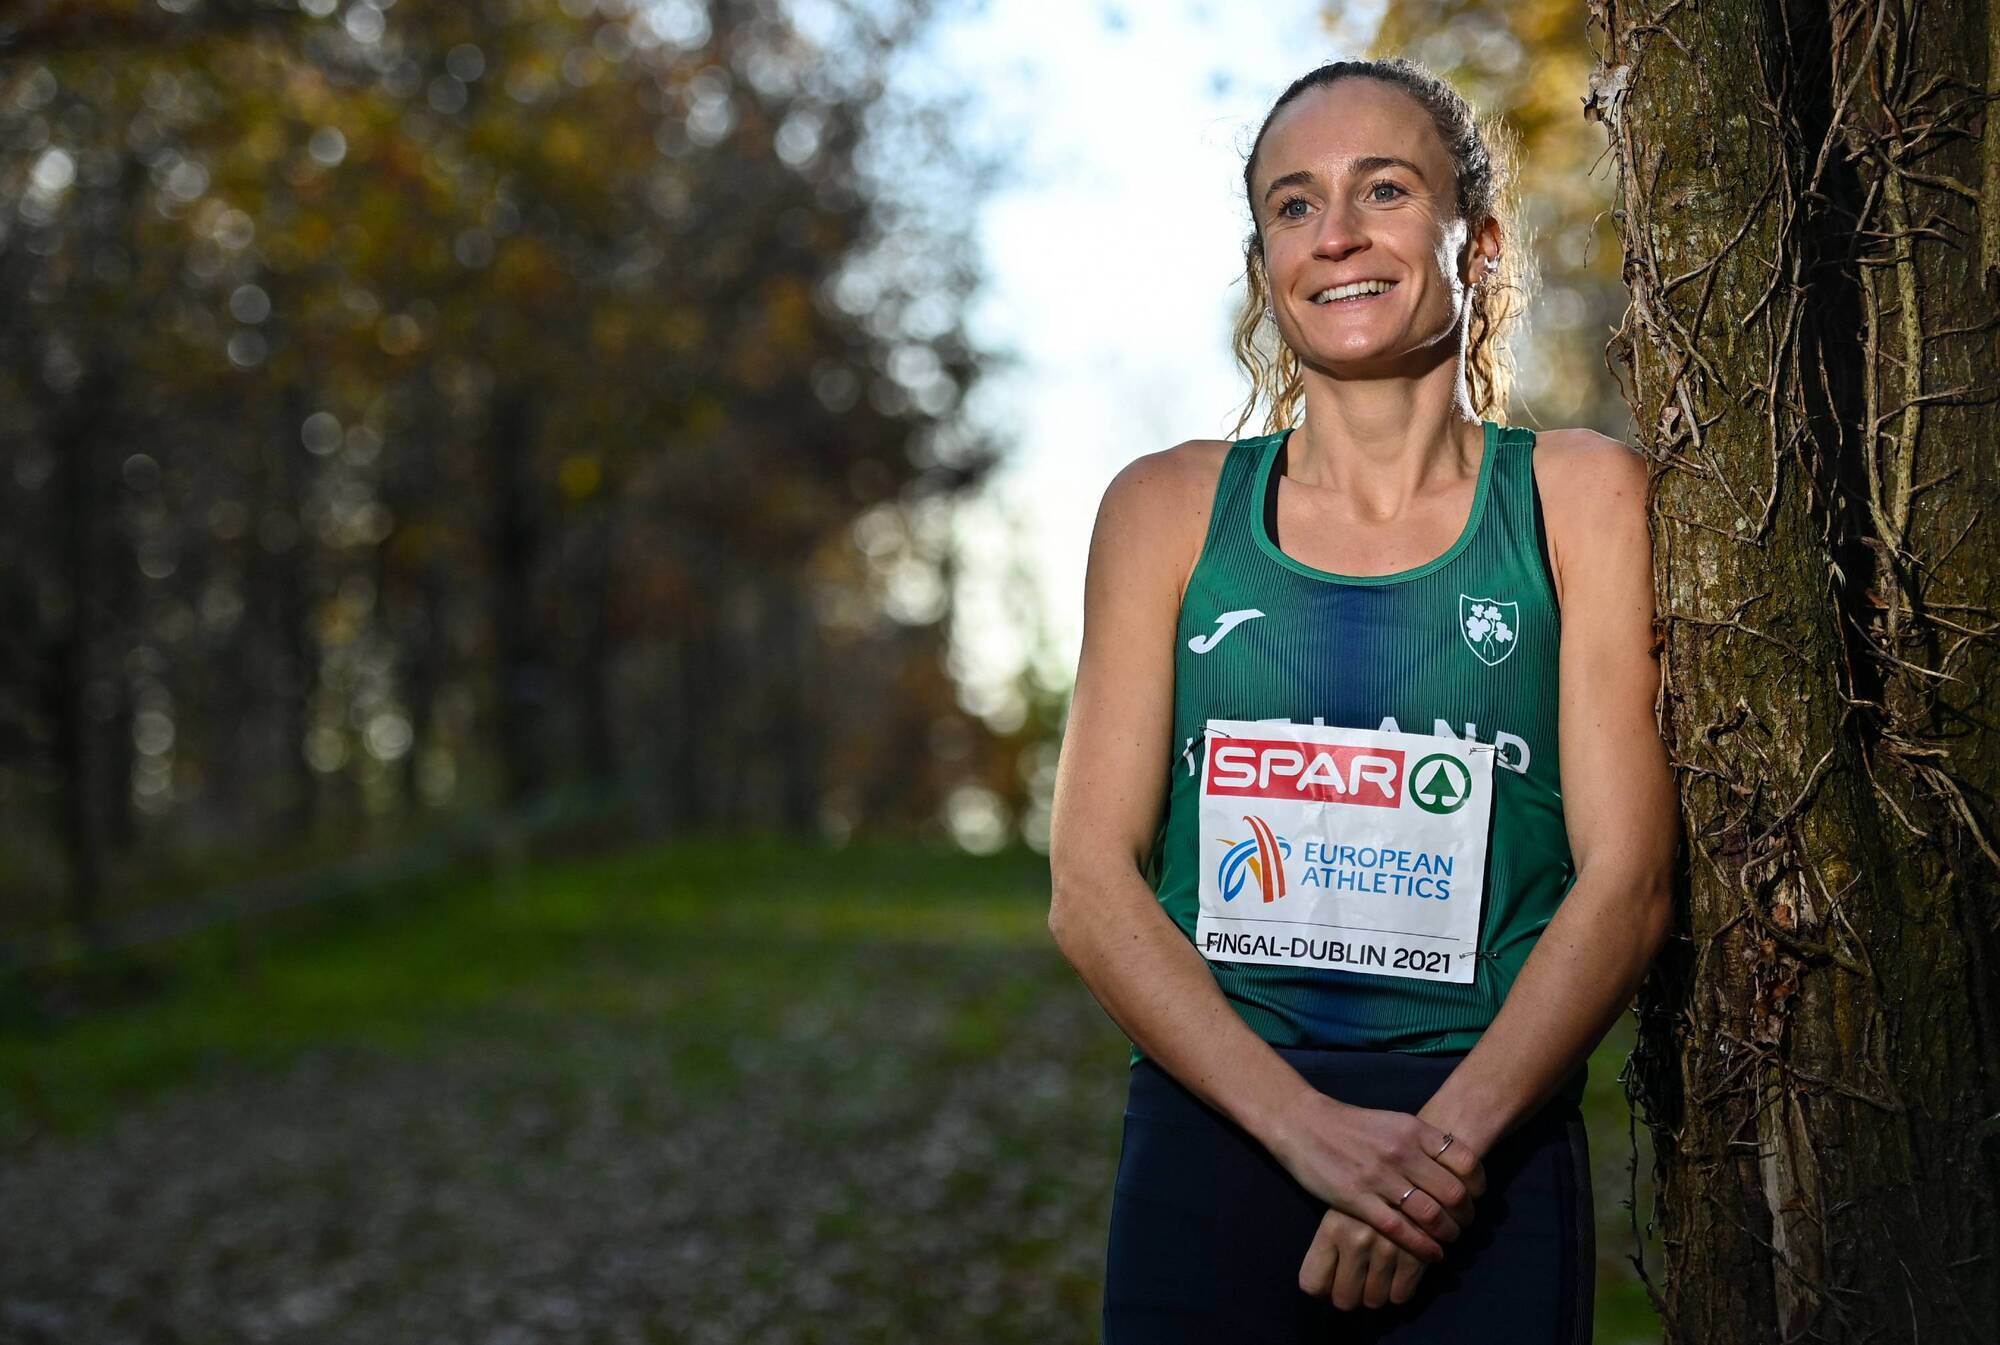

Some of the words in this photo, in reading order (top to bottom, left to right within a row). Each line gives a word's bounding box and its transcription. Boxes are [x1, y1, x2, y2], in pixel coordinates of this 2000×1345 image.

[1213, 747, 1396, 798] SPAR
[1304, 842, 1453, 876] EUROPEAN
[1301, 867, 1451, 900] ATHLETICS
[1206, 932, 1386, 967] FINGAL-DUBLIN
[1392, 948, 1450, 974] 2021
